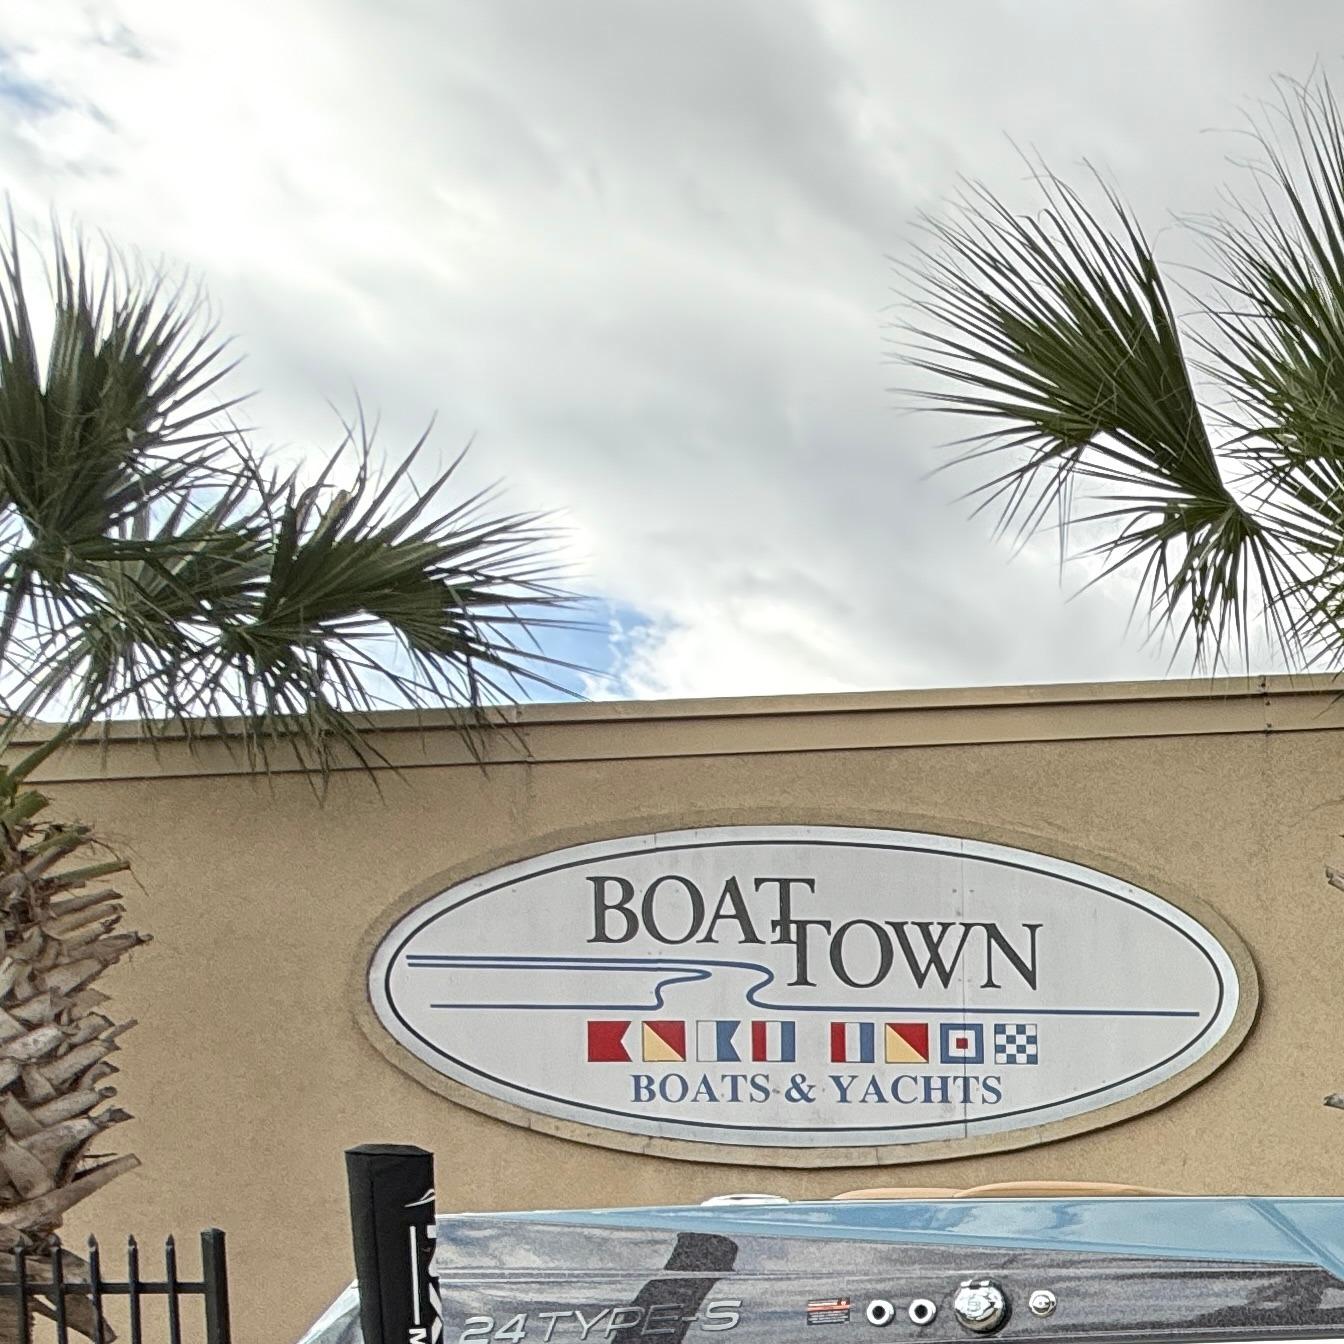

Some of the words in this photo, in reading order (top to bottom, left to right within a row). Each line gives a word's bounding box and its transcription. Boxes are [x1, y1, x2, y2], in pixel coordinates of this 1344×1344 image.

[585, 874, 816, 946] BOAT
[770, 918, 1044, 991] TOWN
[630, 1072, 771, 1103] BOATS
[784, 1073, 817, 1103] &
[829, 1073, 1002, 1105] YACHTS
[537, 1299, 744, 1343] TYPE-S
